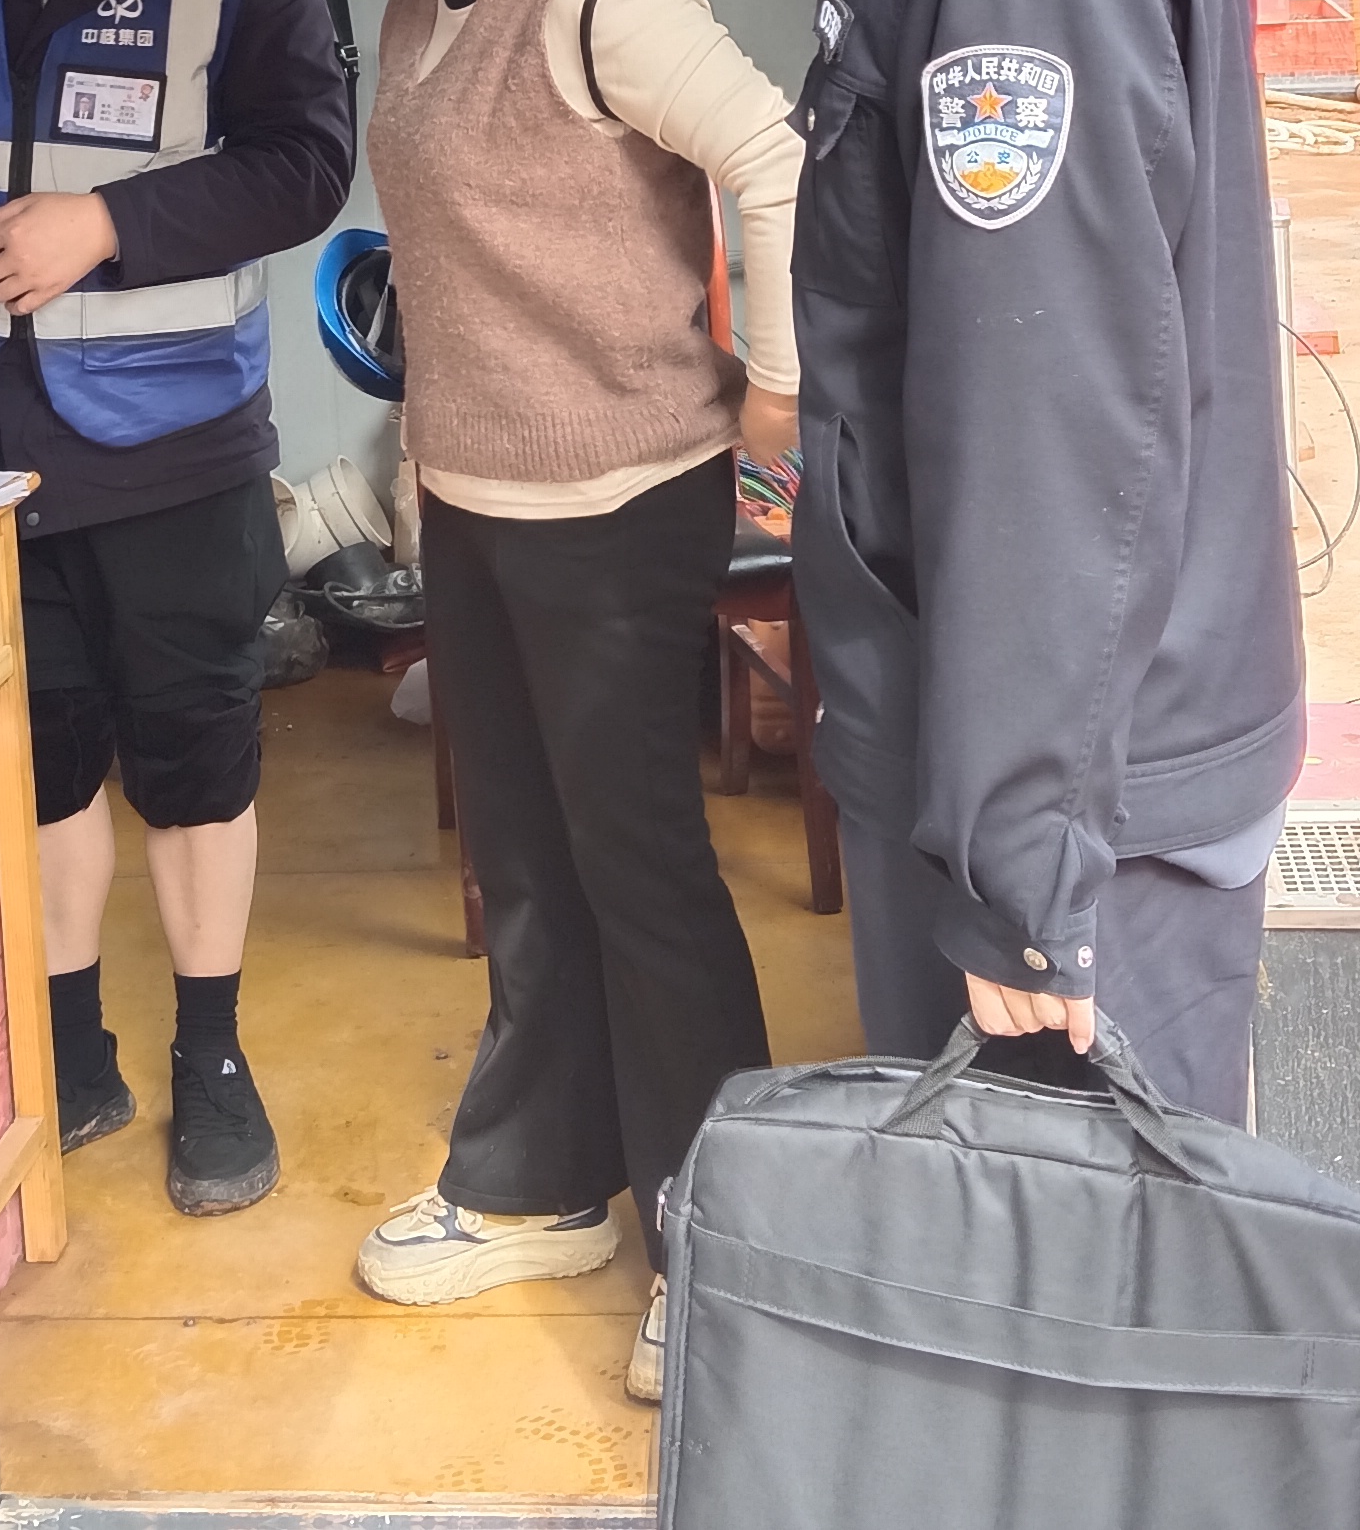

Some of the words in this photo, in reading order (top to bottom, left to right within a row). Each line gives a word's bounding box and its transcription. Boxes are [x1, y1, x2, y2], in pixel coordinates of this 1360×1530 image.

[81, 28, 154, 47] 中核集团
[933, 56, 1060, 96] 中华人民共和国
[938, 95, 1049, 129] 警察
[962, 125, 1019, 143] POLICE
